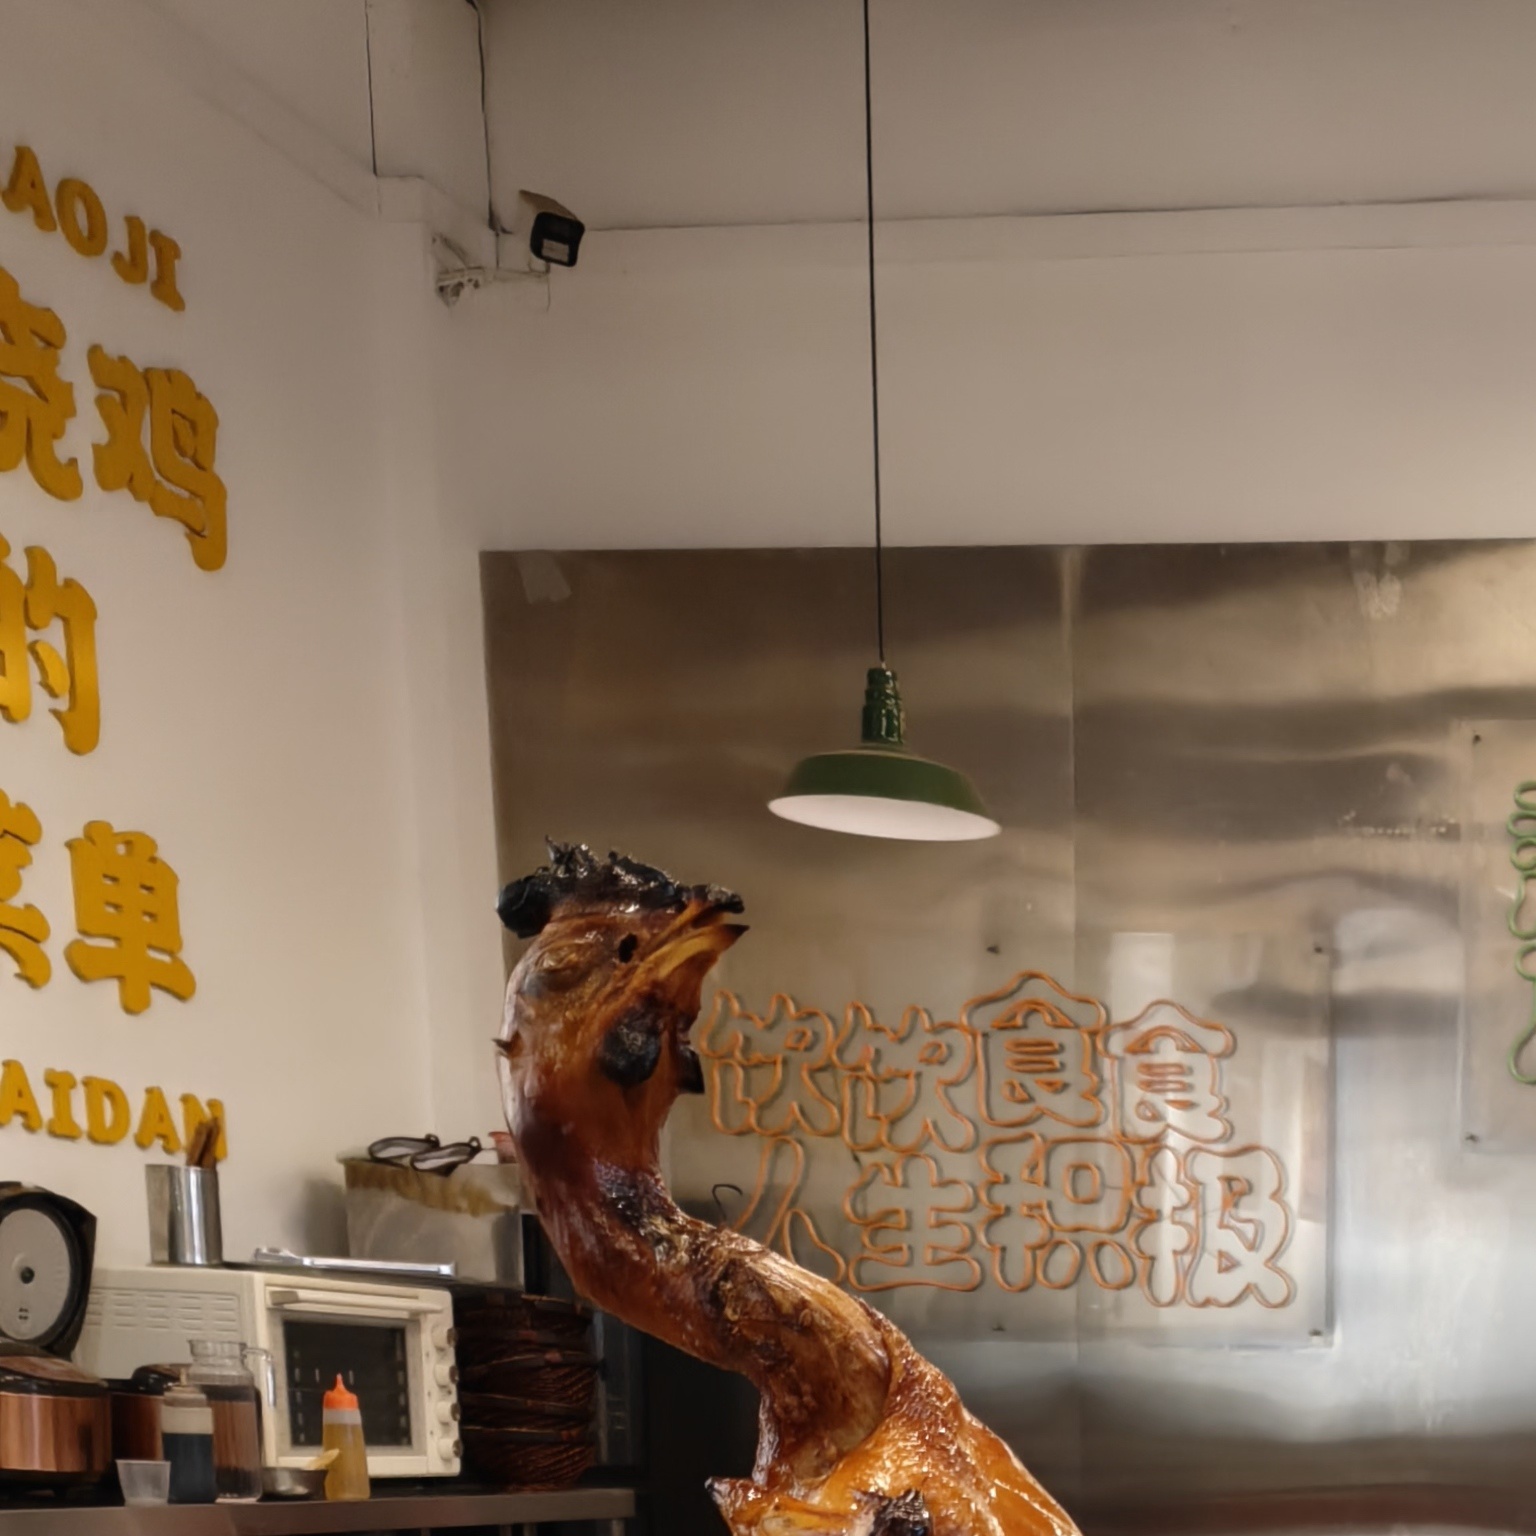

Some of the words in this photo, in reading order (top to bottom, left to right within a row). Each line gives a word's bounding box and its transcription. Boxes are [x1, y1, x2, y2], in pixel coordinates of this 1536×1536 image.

[0, 533, 101, 756] 的
[698, 970, 1237, 1153] 饮饮食食
[732, 1132, 1298, 1310] 人生积极
